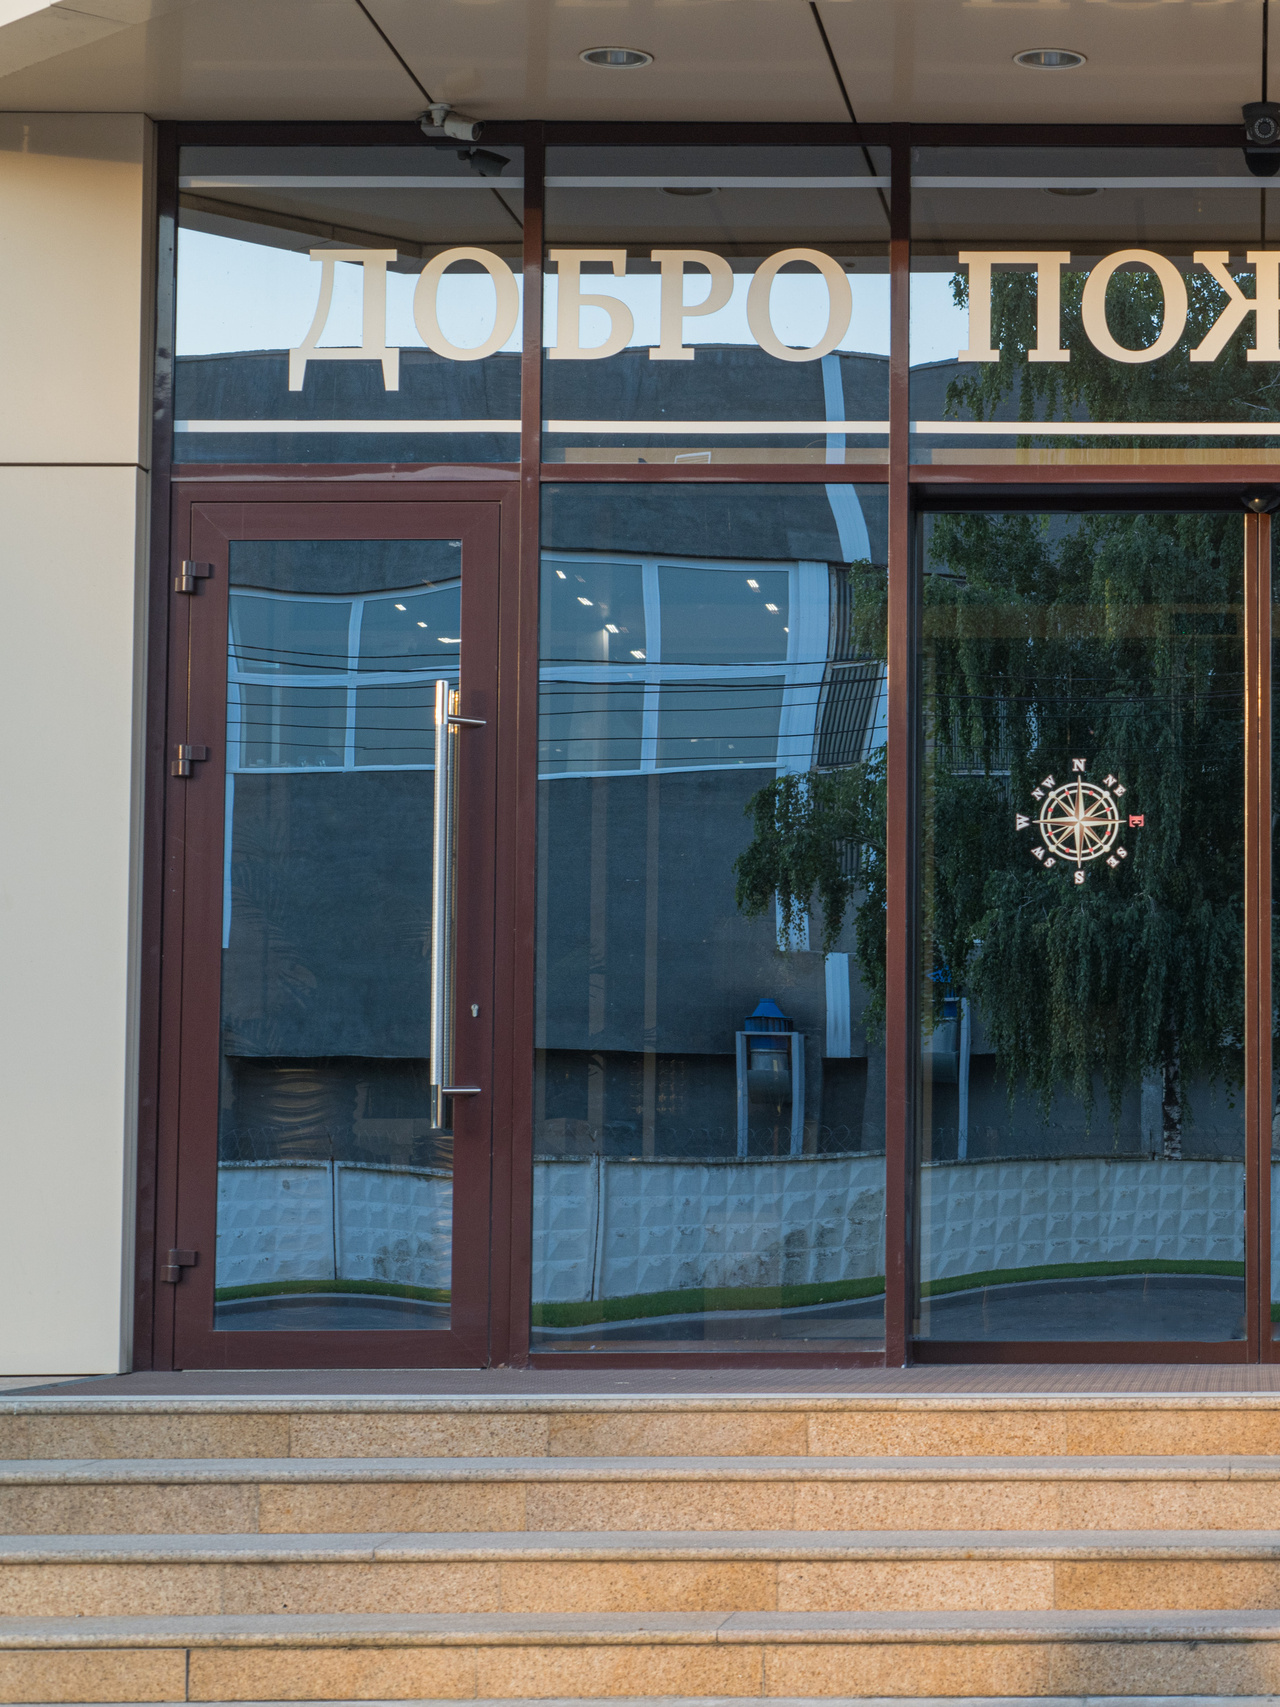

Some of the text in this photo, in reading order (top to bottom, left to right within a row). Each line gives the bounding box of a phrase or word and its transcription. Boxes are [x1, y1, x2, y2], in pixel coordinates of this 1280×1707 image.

[289, 246, 853, 392] ДОБРО
[1072, 758, 1087, 772] N
[1016, 813, 1030, 831] W
[1129, 814, 1144, 828] E
[1074, 870, 1085, 884] S
